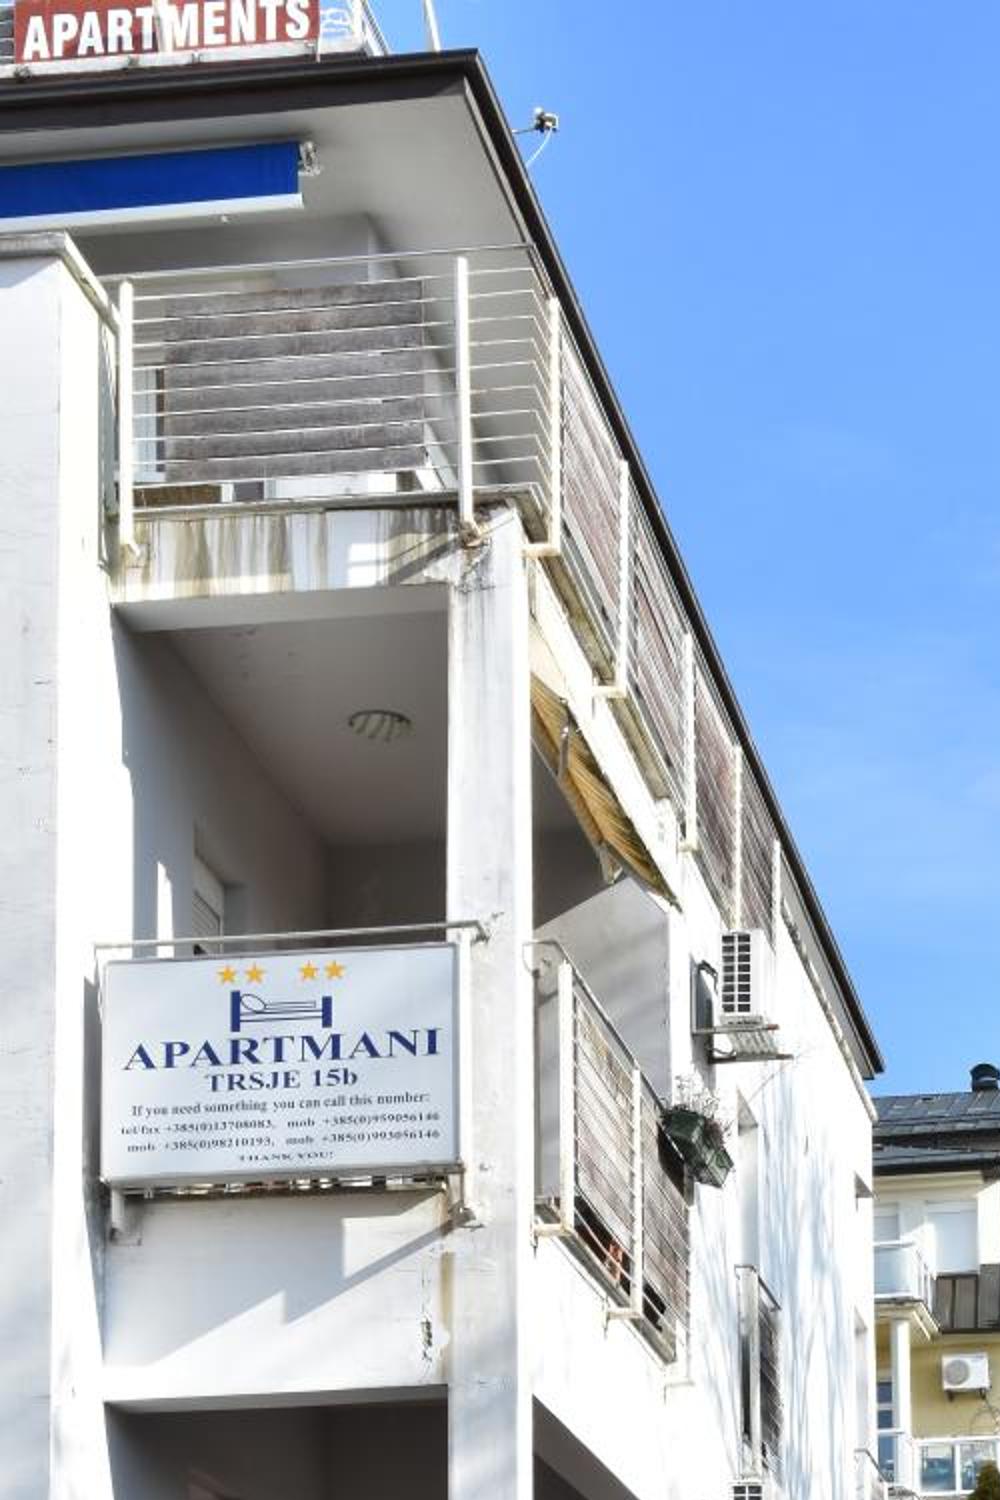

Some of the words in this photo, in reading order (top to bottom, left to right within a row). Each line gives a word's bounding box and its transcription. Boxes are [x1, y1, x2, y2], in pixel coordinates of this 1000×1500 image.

[22, 0, 313, 60] APARTMENTS
[124, 1028, 443, 1071] APARTMANI
[204, 1069, 300, 1093] TRSJE
[313, 1067, 358, 1088] 15b
[132, 1105, 144, 1116] If
[146, 1107, 167, 1118] you
[171, 1104, 201, 1115] need
[204, 1099, 268, 1113] something
[273, 1099, 295, 1112] you
[298, 1098, 321, 1109] can
[323, 1095, 346, 1107] call
[349, 1094, 372, 1105] this
[377, 1091, 430, 1104] number:
[287, 1117, 315, 1129] mob
[127, 1142, 156, 1153] mob
